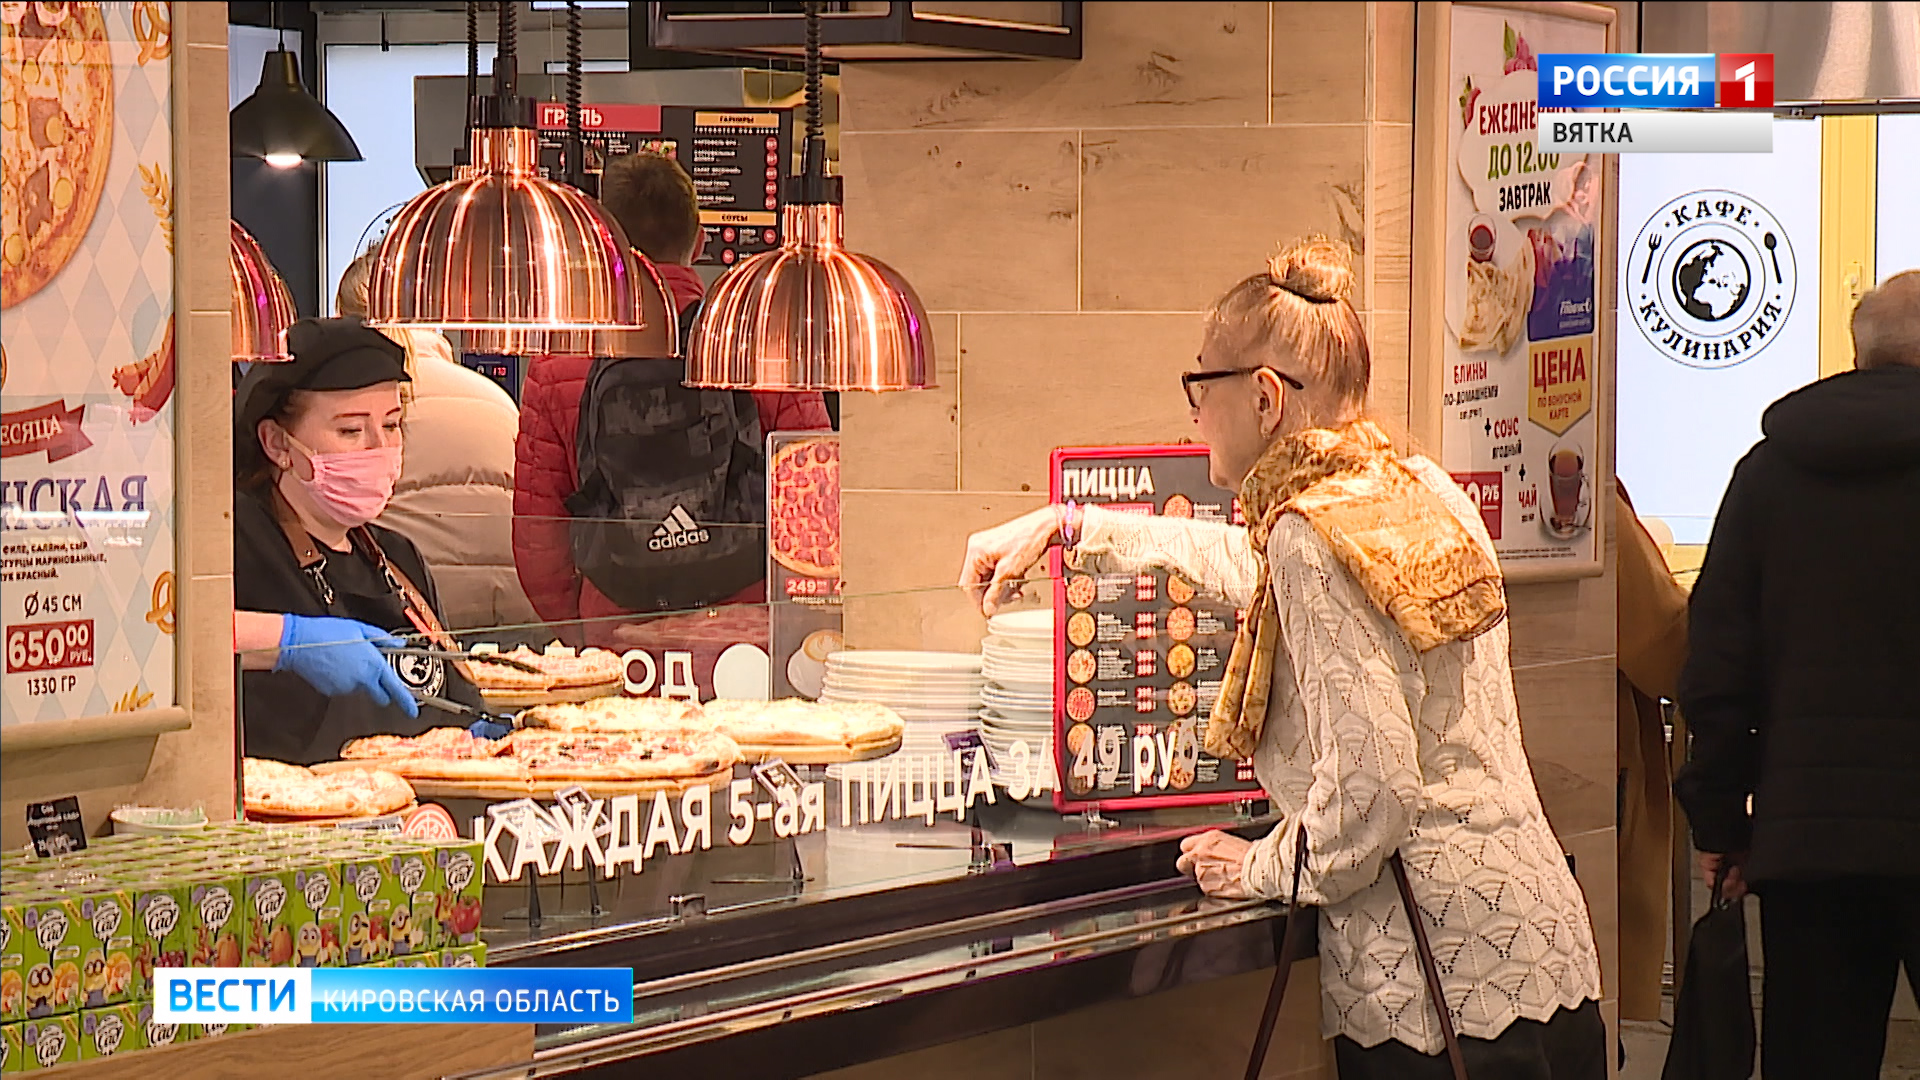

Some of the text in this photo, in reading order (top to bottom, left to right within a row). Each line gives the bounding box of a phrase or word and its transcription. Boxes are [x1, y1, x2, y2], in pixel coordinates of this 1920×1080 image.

[544, 108, 602, 127] ГРЛЬ
[1479, 100, 1562, 137] ЕЖЕДНЕ
[1487, 141, 1561, 180] ДО 12.00
[1498, 181, 1551, 212] ЗАВТРАК
[1671, 200, 1753, 226] КАФЕ
[1639, 300, 1782, 360] КУЛИНАРИЯ
[1453, 361, 1488, 385] БЛИНЫ
[1533, 347, 1587, 393] ЦЕНА
[1443, 385, 1499, 406] ПО-ДОМАШНЕМУ
[1537, 390, 1582, 408] ПО БОНУСНОЙ
[1549, 407, 1569, 420] КАРТЕ
[1494, 416, 1519, 439] СОУС
[1063, 467, 1155, 501] ПИЦЦА
[1482, 483, 1500, 502] РУБ
[1518, 483, 1537, 509] ЧАЙ
[70, 541, 88, 551] СЫР
[648, 529, 710, 551] adidas
[787, 579, 817, 594] 249
[42, 595, 59, 614] 45
[62, 594, 82, 612] СМ
[8, 624, 89, 668] 650 00
[69, 649, 92, 664] РУБ.
[27, 675, 76, 696] 1330 ГР
[474, 784, 712, 883] КАЖДАЯ
[727, 779, 825, 846] 5-ая
[841, 746, 996, 827] ПИЦЦА
[1007, 737, 1063, 801] ЗА
[1074, 727, 1121, 788] 49
[1133, 715, 1198, 794] руб
